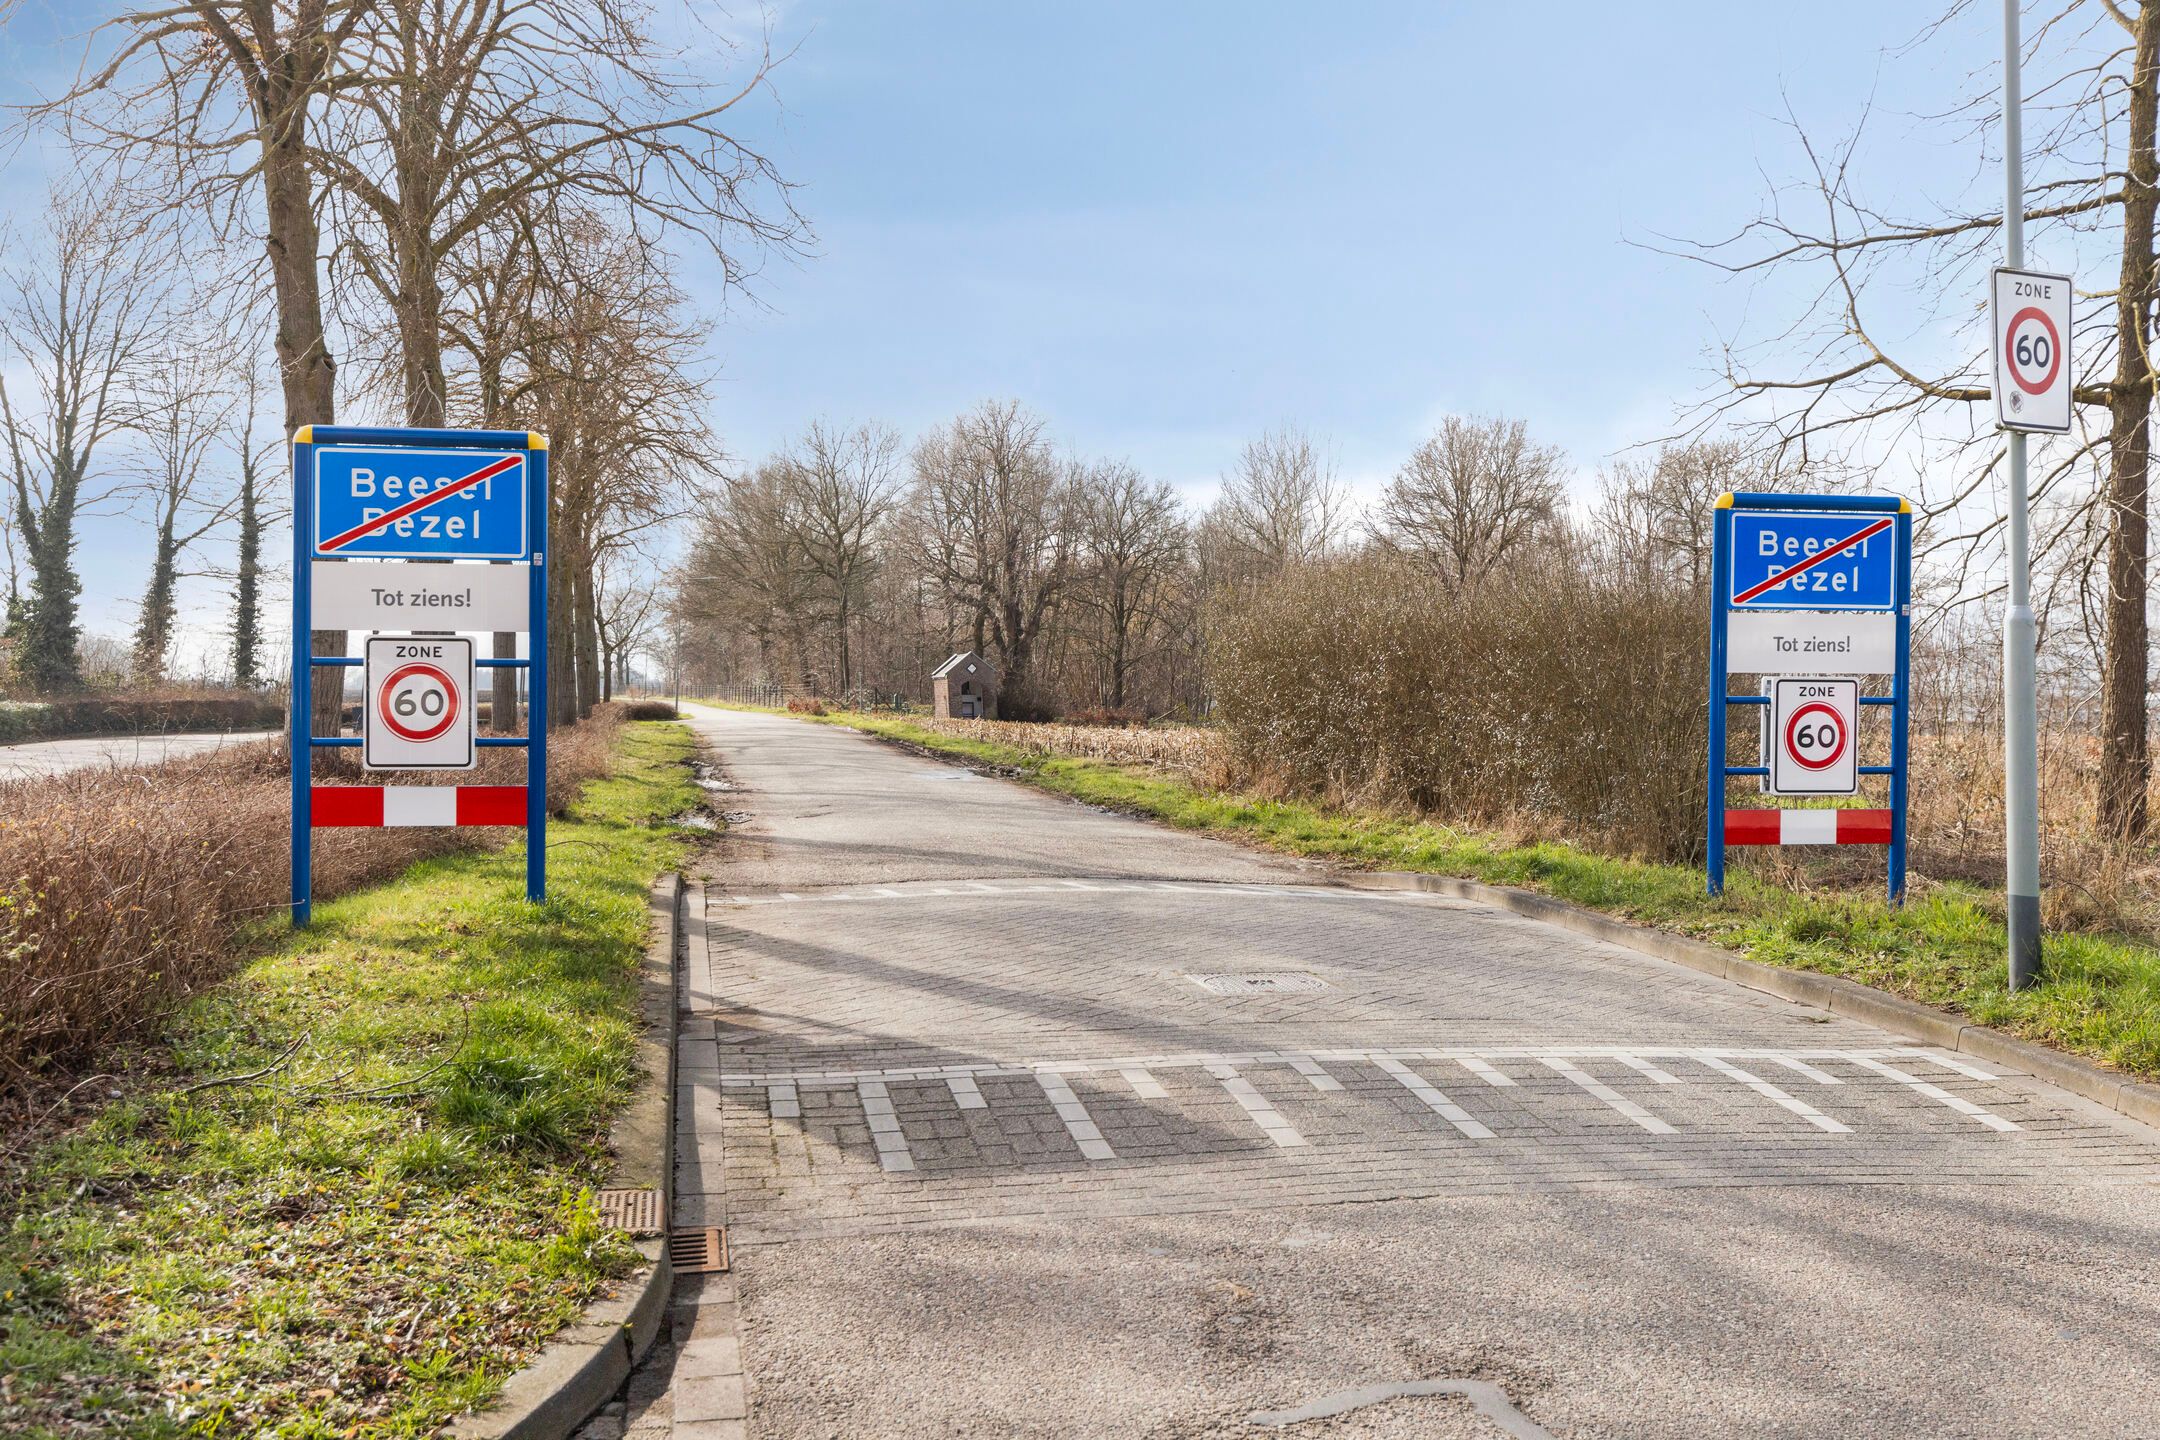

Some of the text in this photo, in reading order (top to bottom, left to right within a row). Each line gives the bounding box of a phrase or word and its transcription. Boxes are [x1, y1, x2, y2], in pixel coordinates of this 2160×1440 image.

[2015, 281, 2052, 299] ZONE
[2016, 334, 2050, 368] 60
[371, 588, 471, 608] Tot ziens!
[396, 646, 443, 658] ZONE
[1773, 635, 1851, 652] Tot ziens!
[1799, 686, 1835, 697] ZONE
[394, 688, 444, 717] 60
[1797, 724, 1836, 749] 60
